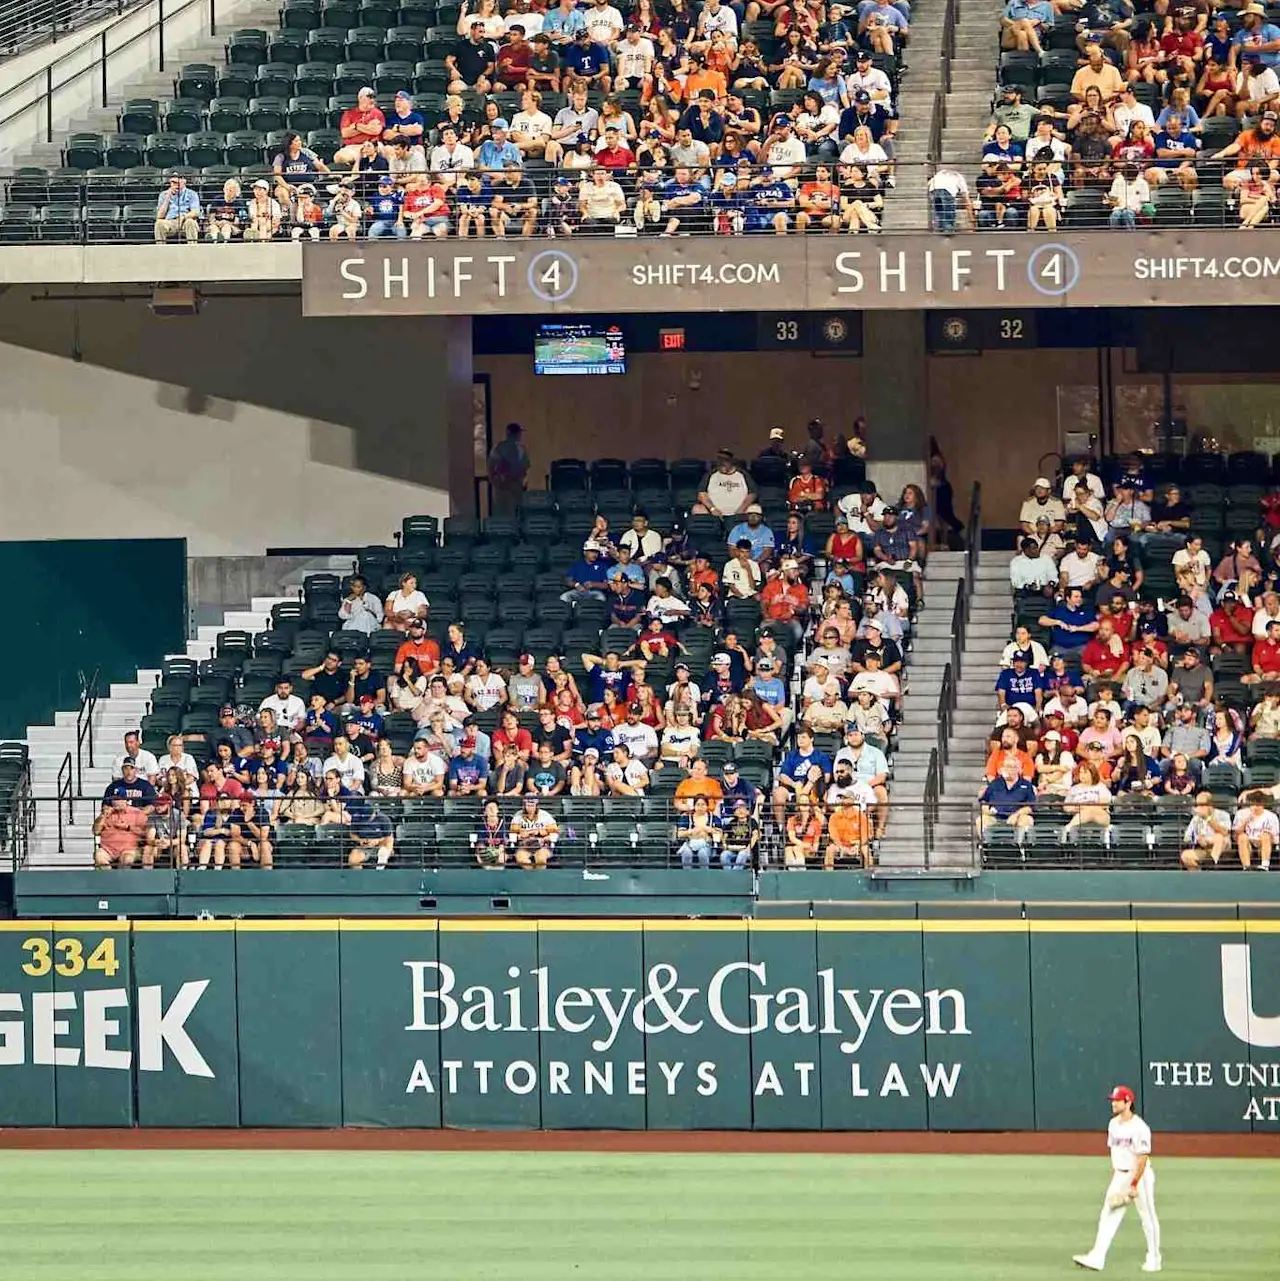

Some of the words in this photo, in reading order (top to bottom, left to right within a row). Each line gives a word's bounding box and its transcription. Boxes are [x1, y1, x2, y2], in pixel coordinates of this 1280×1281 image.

[581, 56, 591, 68] T
[756, 189, 784, 199] TEXAS
[339, 255, 516, 299] SHIFT
[540, 260, 561, 291] 4
[632, 262, 780, 286] SHIFT4.COM
[835, 249, 1015, 293] SHIFT
[1041, 254, 1062, 285] 4
[664, 334, 685, 348] EXIT
[777, 322, 798, 340] 33
[1001, 320, 1022, 339] 32
[21, 937, 120, 977] 334
[403, 960, 972, 1054] Bailey&Galyen
[405, 1059, 718, 1097] ATTORNEYS
[754, 1062, 815, 1097] AT
[850, 1063, 962, 1098] LAW
[1149, 1061, 1214, 1086] THE
